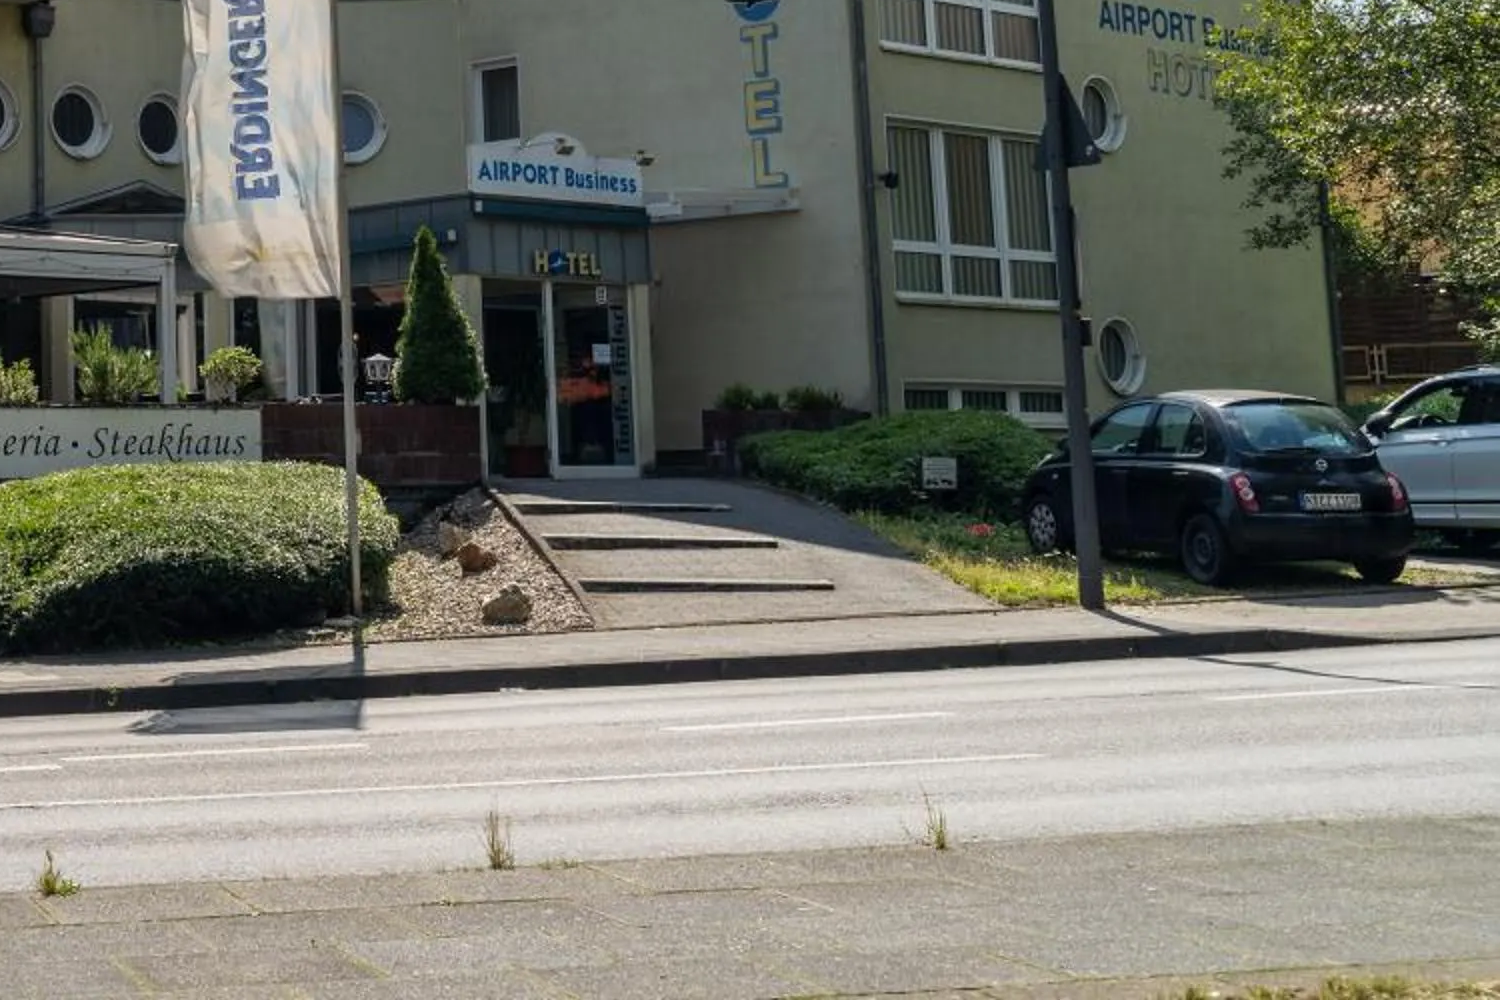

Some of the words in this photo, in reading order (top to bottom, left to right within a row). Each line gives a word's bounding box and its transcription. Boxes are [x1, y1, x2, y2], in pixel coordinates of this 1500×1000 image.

[1099, 0, 1196, 43] AIRPORT
[478, 160, 560, 184] AIRPORT
[564, 169, 637, 194] Business
[87, 422, 247, 463] Steakhaus
